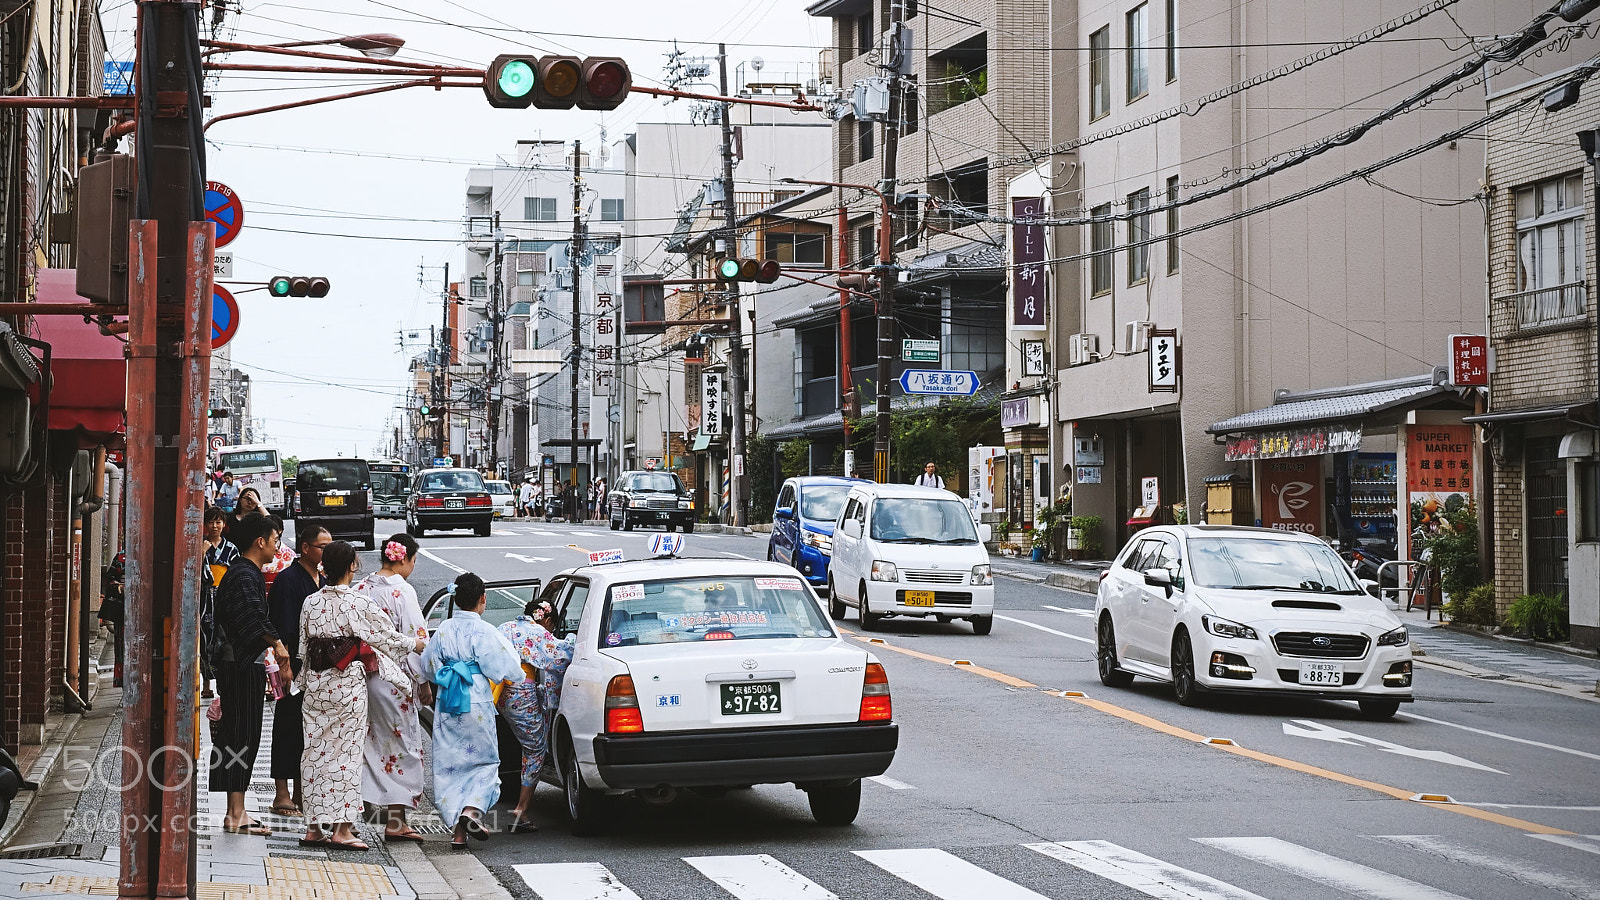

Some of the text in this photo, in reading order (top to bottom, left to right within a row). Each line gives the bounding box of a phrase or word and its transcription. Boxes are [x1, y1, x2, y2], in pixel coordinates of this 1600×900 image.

[213, 183, 232, 197] 17-19
[596, 291, 614, 387] 京都銀行
[1460, 339, 1471, 382] 料理教室
[914, 373, 965, 386] 八坂通り
[922, 384, 958, 392] Yasaka-dori
[706, 374, 718, 434] 伊吹すだれ
[1416, 432, 1450, 441] SUPER
[1425, 443, 1468, 453] MARKET
[661, 535, 674, 552] 京和
[911, 597, 933, 606] 50-11
[1309, 670, 1341, 683] 88-75
[658, 695, 680, 706] 京和
[724, 694, 779, 713] あ 97-82
